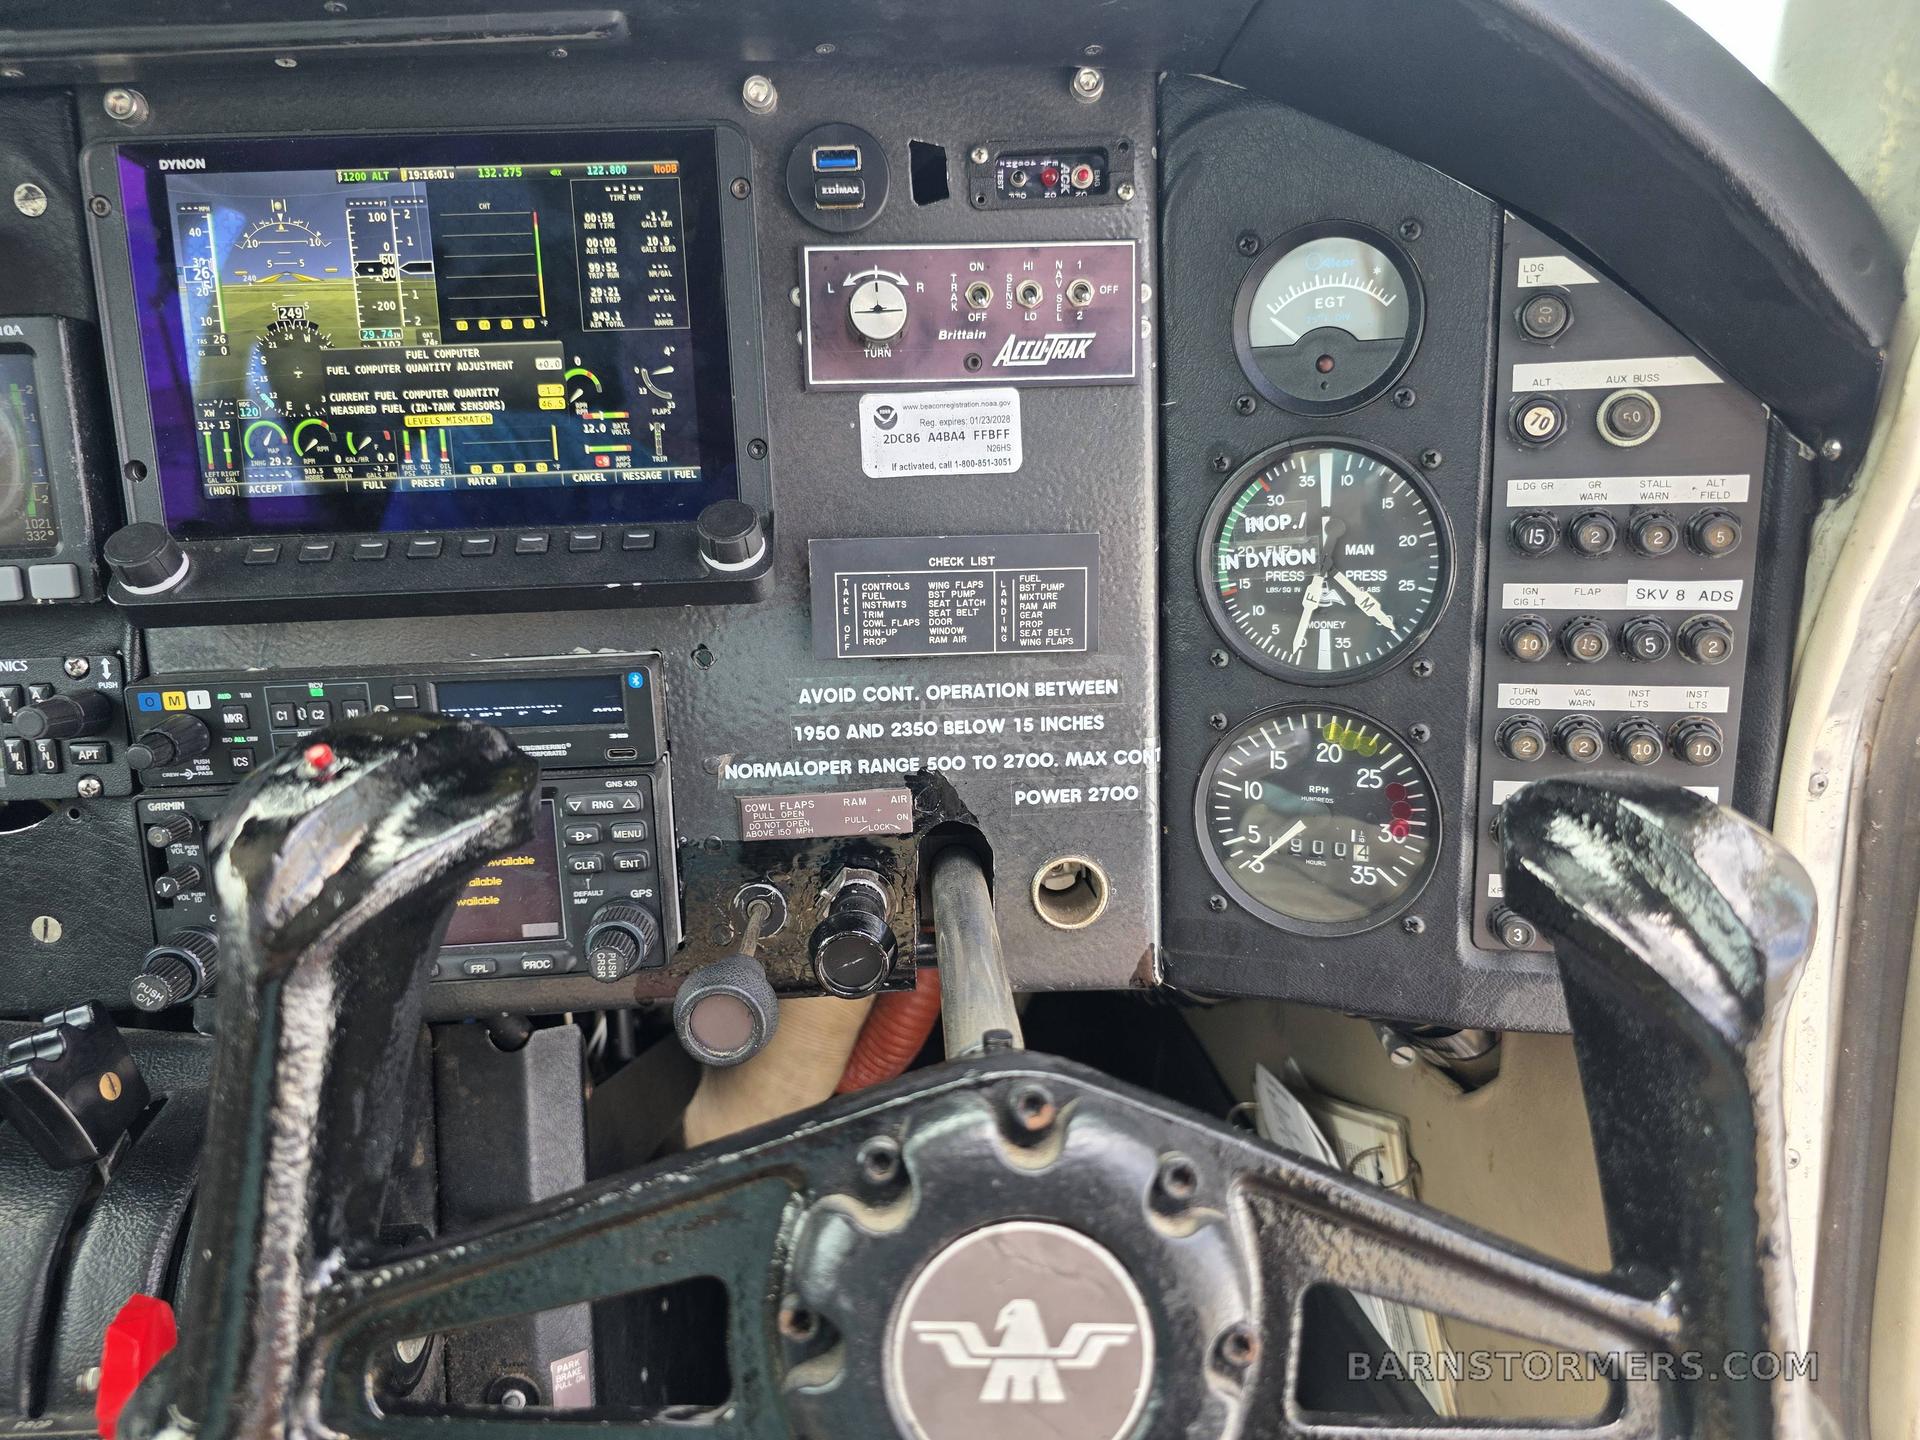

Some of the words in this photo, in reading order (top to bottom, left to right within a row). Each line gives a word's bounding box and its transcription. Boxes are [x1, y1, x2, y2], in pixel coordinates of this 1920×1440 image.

[159, 158, 206, 170] DYNON
[478, 167, 523, 178] 132.275
[586, 165, 627, 176] 122.800
[653, 164, 678, 174] NoDB
[343, 172, 366, 182] 1200
[372, 172, 389, 181] ALT
[969, 262, 984, 272] ON
[1315, 296, 1346, 309] EGT
[968, 313, 987, 322] OFF
[938, 329, 986, 340] Brittain
[405, 350, 429, 359] FUEL
[434, 348, 480, 358] COMPUTER
[864, 349, 892, 358] TURN
[326, 365, 350, 376] FUEL
[355, 364, 401, 374] COMPUTER
[406, 363, 451, 373] QUANTITY
[457, 361, 514, 371] ADJUSTMENT
[1532, 378, 1551, 387] ALT
[1606, 375, 1627, 384] AUX
[1633, 373, 1660, 383] BUSS
[330, 392, 369, 402] CURRENT
[375, 391, 398, 401] FUEL
[403, 390, 449, 400] COMPUTER
[454, 388, 499, 398] QUANTITY
[330, 405, 377, 415] MEASURED
[382, 404, 405, 414] FUEL
[410, 402, 455, 413] (IN-TANK
[461, 401, 505, 412] SENSORS)
[903, 400, 1011, 411] www.beaconregistration.noaa.gov
[408, 416, 441, 424] LEVELS
[446, 415, 491, 424] MISMATCH
[920, 418, 937, 427] Reg.
[970, 415, 1011, 424] 01/23/2028
[883, 434, 920, 444] 2DC86
[928, 431, 965, 442] A4BA4
[974, 429, 1010, 440] FFBFF
[986, 444, 1011, 452] N26HS
[900, 461, 937, 471] activated,
[939, 460, 952, 469] call
[955, 458, 1011, 468] 1-800-851-3051
[208, 485, 236, 496] (HDG)
[249, 484, 283, 494] ACCEPT
[363, 480, 387, 490] FULL
[411, 479, 445, 488] PRESET
[468, 477, 497, 486] MATCH
[573, 472, 607, 482] CANCEL
[622, 470, 662, 481] MESSAGE
[674, 469, 696, 479] FUEL
[1516, 482, 1536, 490] LDG
[1540, 482, 1554, 490] GR
[1588, 481, 1602, 489] GR
[1640, 480, 1672, 488] STALL
[1706, 479, 1726, 487] ALT
[1579, 492, 1607, 501] WARN
[1640, 491, 1669, 500] WARN
[1700, 490, 1731, 499] FIELD
[1345, 545, 1374, 555] MAN
[928, 557, 964, 566] CHECK
[971, 556, 995, 566] LIST
[1246, 549, 1316, 568] DYNON
[1019, 574, 1041, 582] FUEL
[1345, 570, 1387, 581] PRESS
[862, 582, 910, 590] CONTROLS
[928, 581, 950, 590] WING
[955, 581, 984, 589] FLAPS
[1019, 584, 1036, 592] BST
[1041, 583, 1064, 591] PUMP
[928, 590, 946, 598] BST
[951, 590, 976, 598] PUMP
[1522, 587, 1538, 595] IGN
[1574, 588, 1601, 596] FLAP
[1636, 588, 1669, 600] SKV
[1676, 589, 1685, 601] 8
[1699, 590, 1734, 602] ADS
[862, 592, 886, 600] FUEL
[1020, 592, 1058, 600] MIXTURE
[863, 601, 907, 609] INSTRMTS
[928, 600, 952, 608] SEAT
[957, 599, 986, 607] LATCH
[1020, 602, 1038, 610] RAM
[1043, 602, 1057, 610] AIR
[1513, 598, 1530, 606] CIG
[1533, 598, 1545, 606] LT
[863, 610, 884, 618] TRIM
[929, 609, 952, 617] SEAT
[956, 608, 979, 616] BELT
[1020, 611, 1043, 619] GEAR
[863, 619, 886, 627] COWL
[891, 618, 920, 626] FLAPS
[929, 618, 952, 626] DOOR
[1020, 620, 1043, 628] PROP
[863, 628, 897, 636] RUN-UP
[929, 627, 964, 635] WINDOW
[1020, 629, 1043, 637] SEAT
[1048, 628, 1071, 636] BELT
[863, 638, 887, 646] PROP
[929, 636, 948, 644] RAM
[952, 635, 967, 643] AIR
[1020, 638, 1041, 646] WING
[1045, 637, 1074, 645] FLAPS
[798, 687, 856, 704] AVOID
[862, 686, 920, 702] CONT.
[926, 682, 1029, 700] OPERATION
[1034, 679, 1118, 697] BETWEEN
[1628, 690, 1650, 698] INST
[1509, 698, 1540, 706] COORD
[1568, 699, 1595, 707] WARN
[1630, 700, 1649, 708] LTS
[794, 724, 840, 742] 1950
[846, 723, 884, 740] AND
[890, 721, 938, 737] 2350
[943, 718, 1005, 736] BELOW
[1014, 717, 1034, 732] 15
[1040, 714, 1105, 732] INCHES
[79, 751, 99, 760] APT
[1316, 742, 1342, 763] 20
[858, 756, 920, 775] RANGE
[927, 755, 966, 772] 500
[972, 754, 997, 770] TO
[1003, 752, 1058, 769] 2700.
[1065, 750, 1107, 767] MAX
[1270, 750, 1287, 770] 15
[1356, 768, 1382, 788] 25
[1245, 781, 1263, 800] 10
[1309, 786, 1329, 794] RPM
[1014, 788, 1082, 805] POWER
[1088, 786, 1138, 802] 2700
[592, 800, 614, 810] RNG
[843, 797, 867, 806] RAM
[891, 795, 908, 804] AIR
[148, 801, 185, 811] GARMIN
[745, 803, 774, 812] COWL
[780, 801, 815, 810] FLAPS
[845, 816, 867, 824] PULL
[897, 813, 909, 821] ON
[787, 820, 810, 828] OPEN
[614, 829, 642, 839] MENU
[746, 829, 774, 838] ABOVE
[778, 828, 791, 836] 150
[574, 860, 595, 870] CLR
[620, 859, 640, 869] ENT
[1350, 865, 1377, 885] 35
[523, 959, 550, 969] PROC
